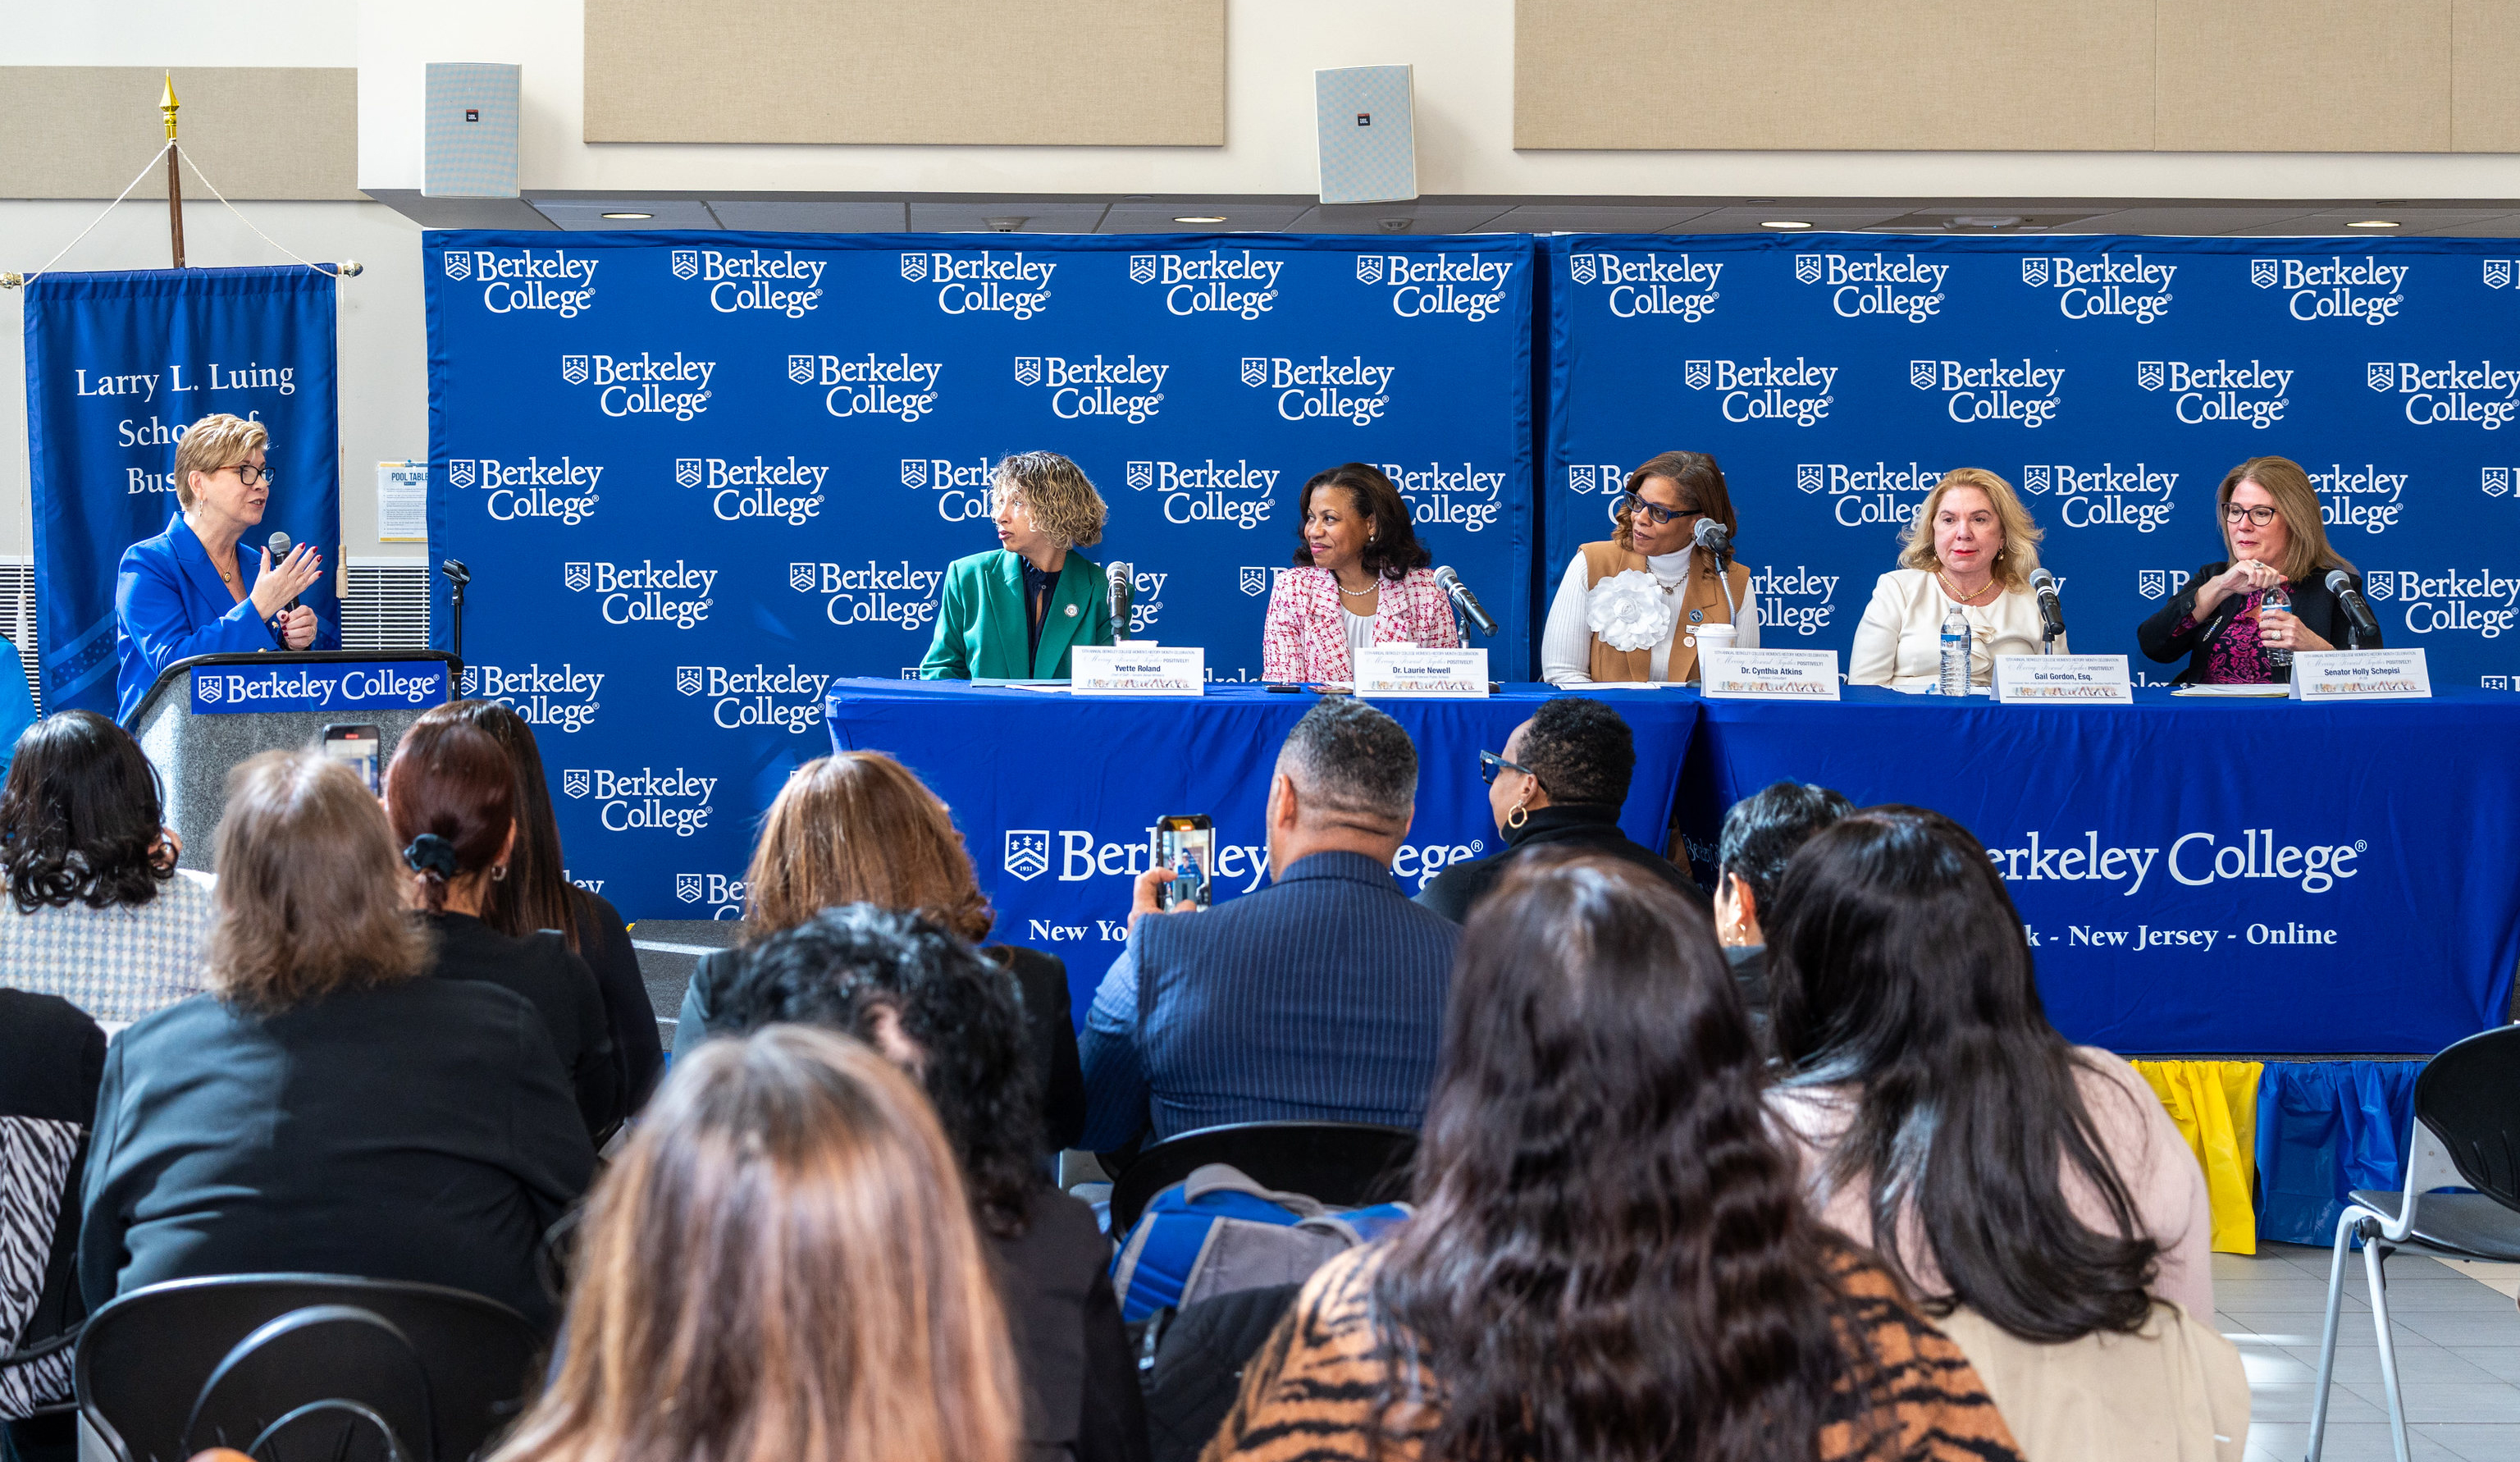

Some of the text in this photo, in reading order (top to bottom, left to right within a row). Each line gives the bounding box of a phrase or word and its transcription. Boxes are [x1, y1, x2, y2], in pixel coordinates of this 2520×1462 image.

[474, 250, 599, 287] Berkeley
[702, 250, 827, 288] Berkeley
[932, 251, 1057, 290] Berkeley
[1161, 250, 1284, 289] Berkeley
[1388, 253, 1513, 290] Berkeley
[1599, 254, 1723, 291] Berkeley
[1825, 254, 1949, 292] Berkeley
[2052, 254, 2177, 293] Berkeley
[2282, 256, 2408, 294] Berkeley
[75, 362, 295, 402] Larry L. Luing
[592, 352, 715, 390] Berkeley
[819, 353, 943, 391] Berkeley
[1045, 354, 1169, 393] Berkeley
[1271, 356, 1395, 395] Berkeley
[1715, 357, 1838, 395] Berkeley
[1941, 359, 2065, 396] Berkeley
[2168, 359, 2294, 397] Berkeley
[2399, 360, 2520, 399] Berkeley
[391, 473, 408, 481] POOL
[480, 456, 604, 494] Berkeley
[706, 456, 829, 494] Berkeley
[1157, 459, 1280, 498] Berkeley
[2055, 463, 2179, 501] Berkeley
[2308, 464, 2408, 502] erkeley
[595, 560, 718, 598] Berkeley
[820, 560, 943, 599] Berkeley
[2399, 569, 2520, 606] Berkeley
[226, 671, 337, 706] Berkeley
[482, 664, 605, 701] Berkeley
[707, 665, 829, 702] Berkeley
[1752, 667, 1778, 675] Cynthia
[2372, 667, 2400, 675] Schepisi
[595, 768, 717, 806] Berkeley
[1029, 919, 1089, 942] New
[2068, 925, 2130, 947] New
[2133, 925, 2219, 952] Jersey
[2246, 922, 2337, 944] Online
